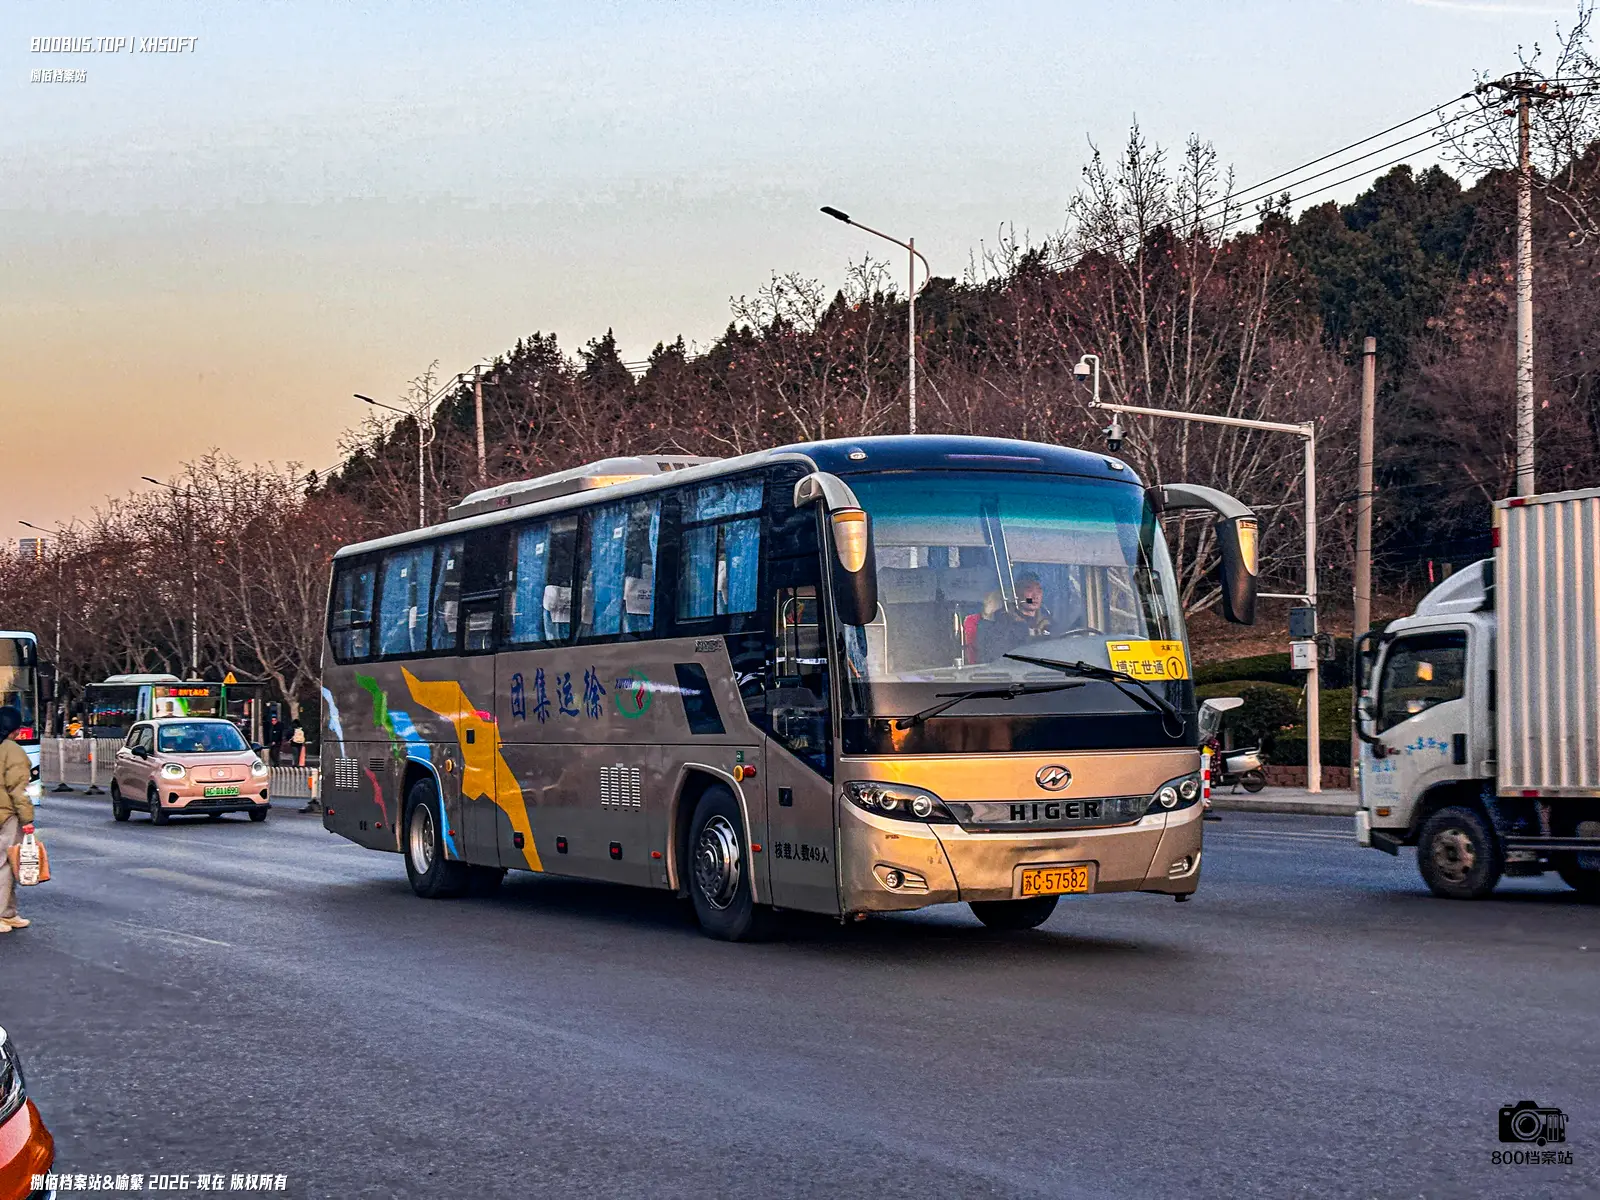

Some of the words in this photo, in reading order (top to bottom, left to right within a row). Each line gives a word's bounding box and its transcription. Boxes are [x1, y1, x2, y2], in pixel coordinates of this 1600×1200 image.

[1116, 660, 1165, 675] 博汇世通
[1009, 801, 1100, 821] HIGER
[775, 842, 829, 864] 核载人数49人
